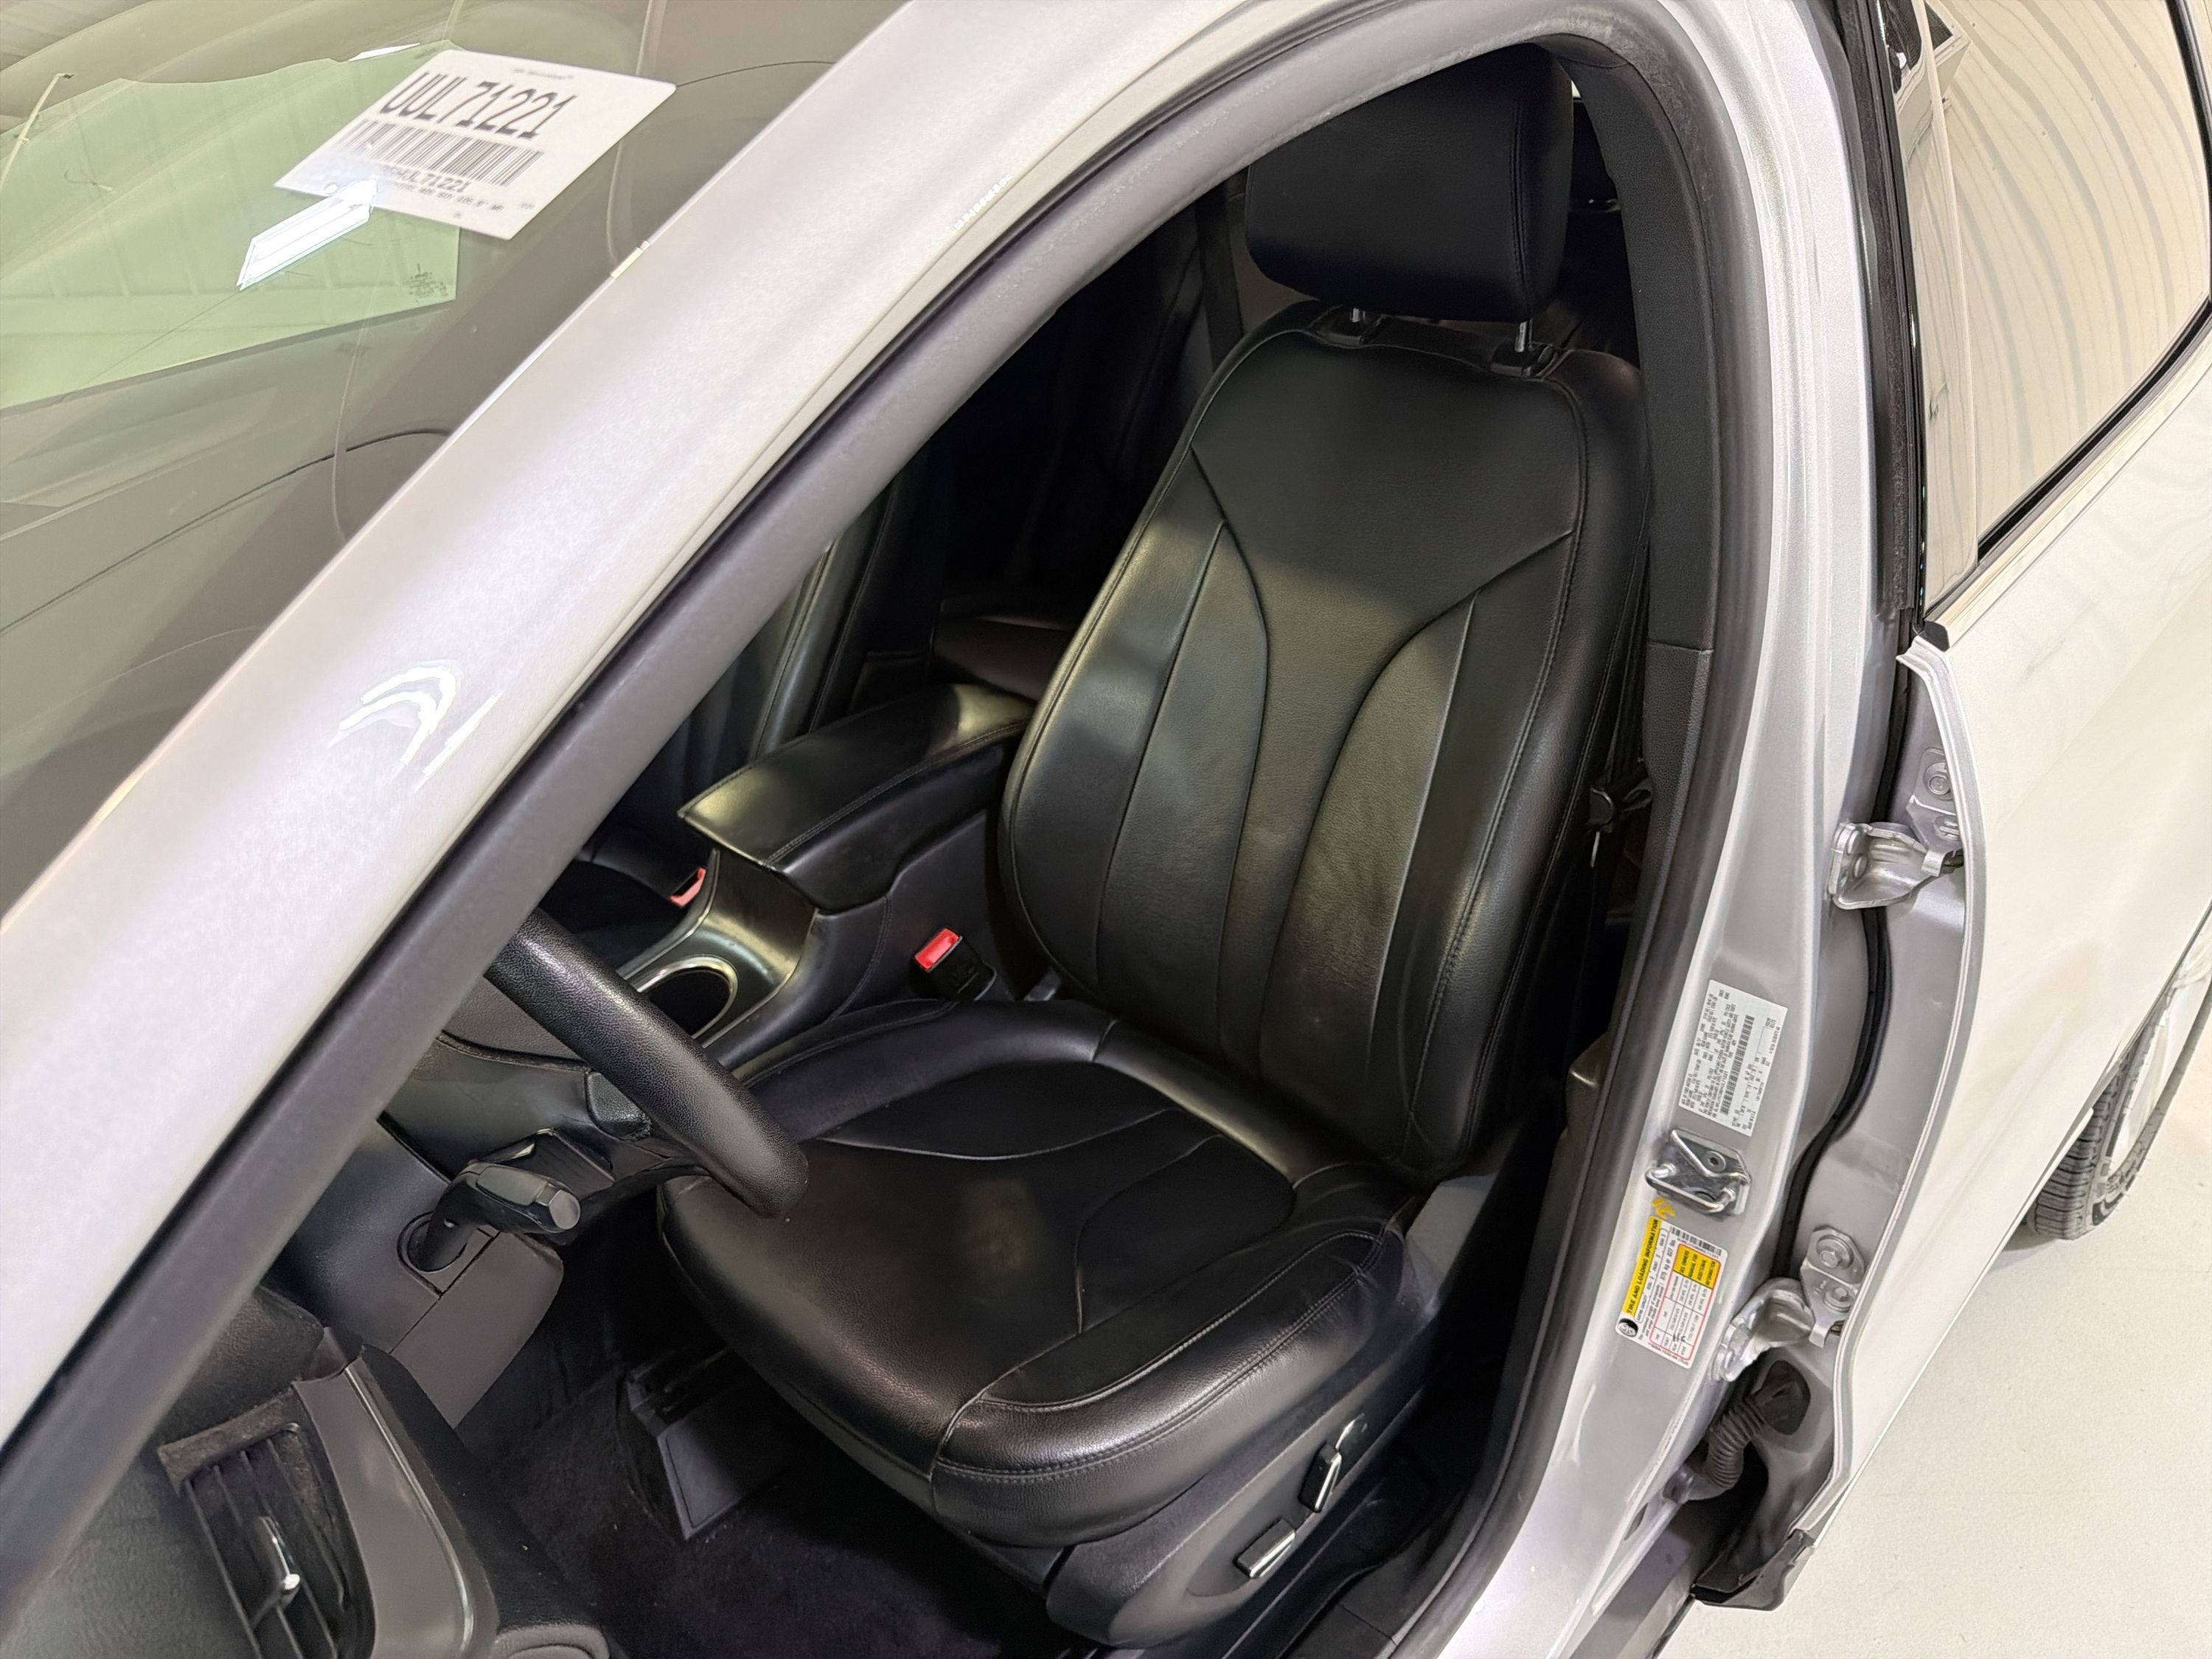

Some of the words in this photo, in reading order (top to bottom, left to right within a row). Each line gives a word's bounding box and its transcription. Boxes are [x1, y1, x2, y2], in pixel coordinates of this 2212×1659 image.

[1627, 1298, 1635, 1314] TIRE
[1638, 1259, 1648, 1284] LOADING
[1645, 1218, 1658, 1257] INFORMATION
